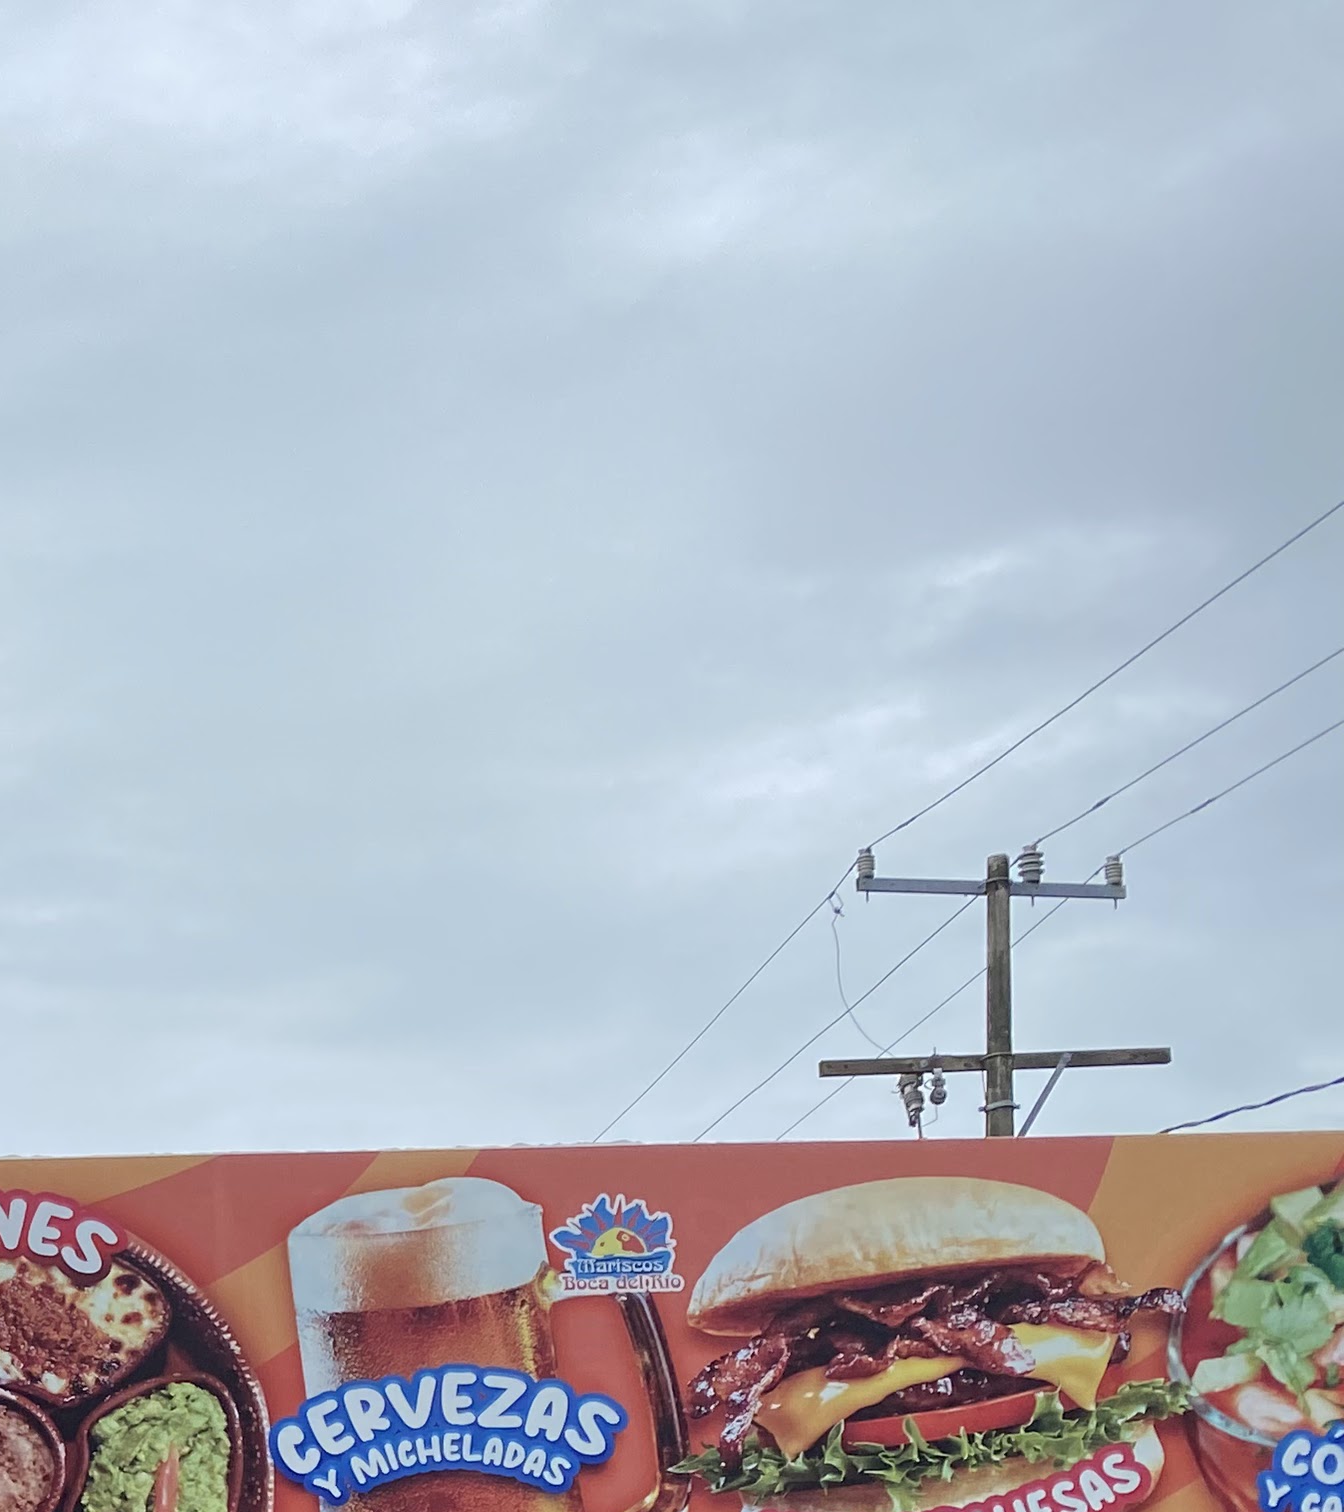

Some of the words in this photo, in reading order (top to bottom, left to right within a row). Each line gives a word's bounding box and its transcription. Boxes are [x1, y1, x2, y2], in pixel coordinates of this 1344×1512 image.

[576, 1258, 664, 1274] Mariscos
[562, 1275, 609, 1291] Boca
[615, 1273, 644, 1290] del
[651, 1273, 682, 1289] Río
[276, 1370, 621, 1473] CERVEZAS
[313, 1466, 343, 1501] Y
[348, 1431, 572, 1489] MICHELADAS
[1266, 1478, 1292, 1508] Y
